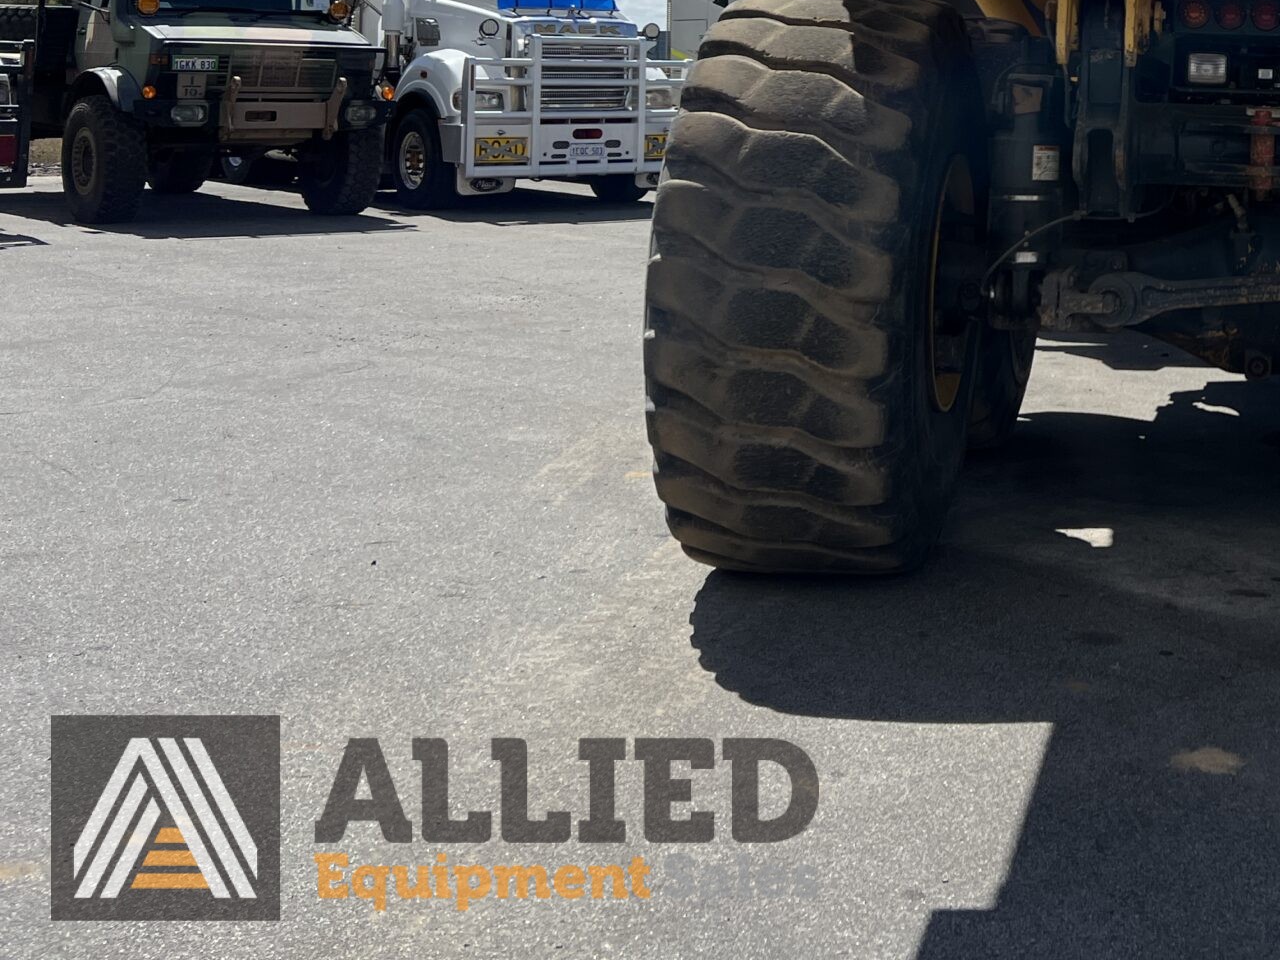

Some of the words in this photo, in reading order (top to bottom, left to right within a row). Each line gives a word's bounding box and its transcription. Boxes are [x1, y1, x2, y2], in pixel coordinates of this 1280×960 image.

[534, 24, 622, 34] MACK
[175, 60, 197, 70] 1GKK
[200, 60, 216, 70] 830
